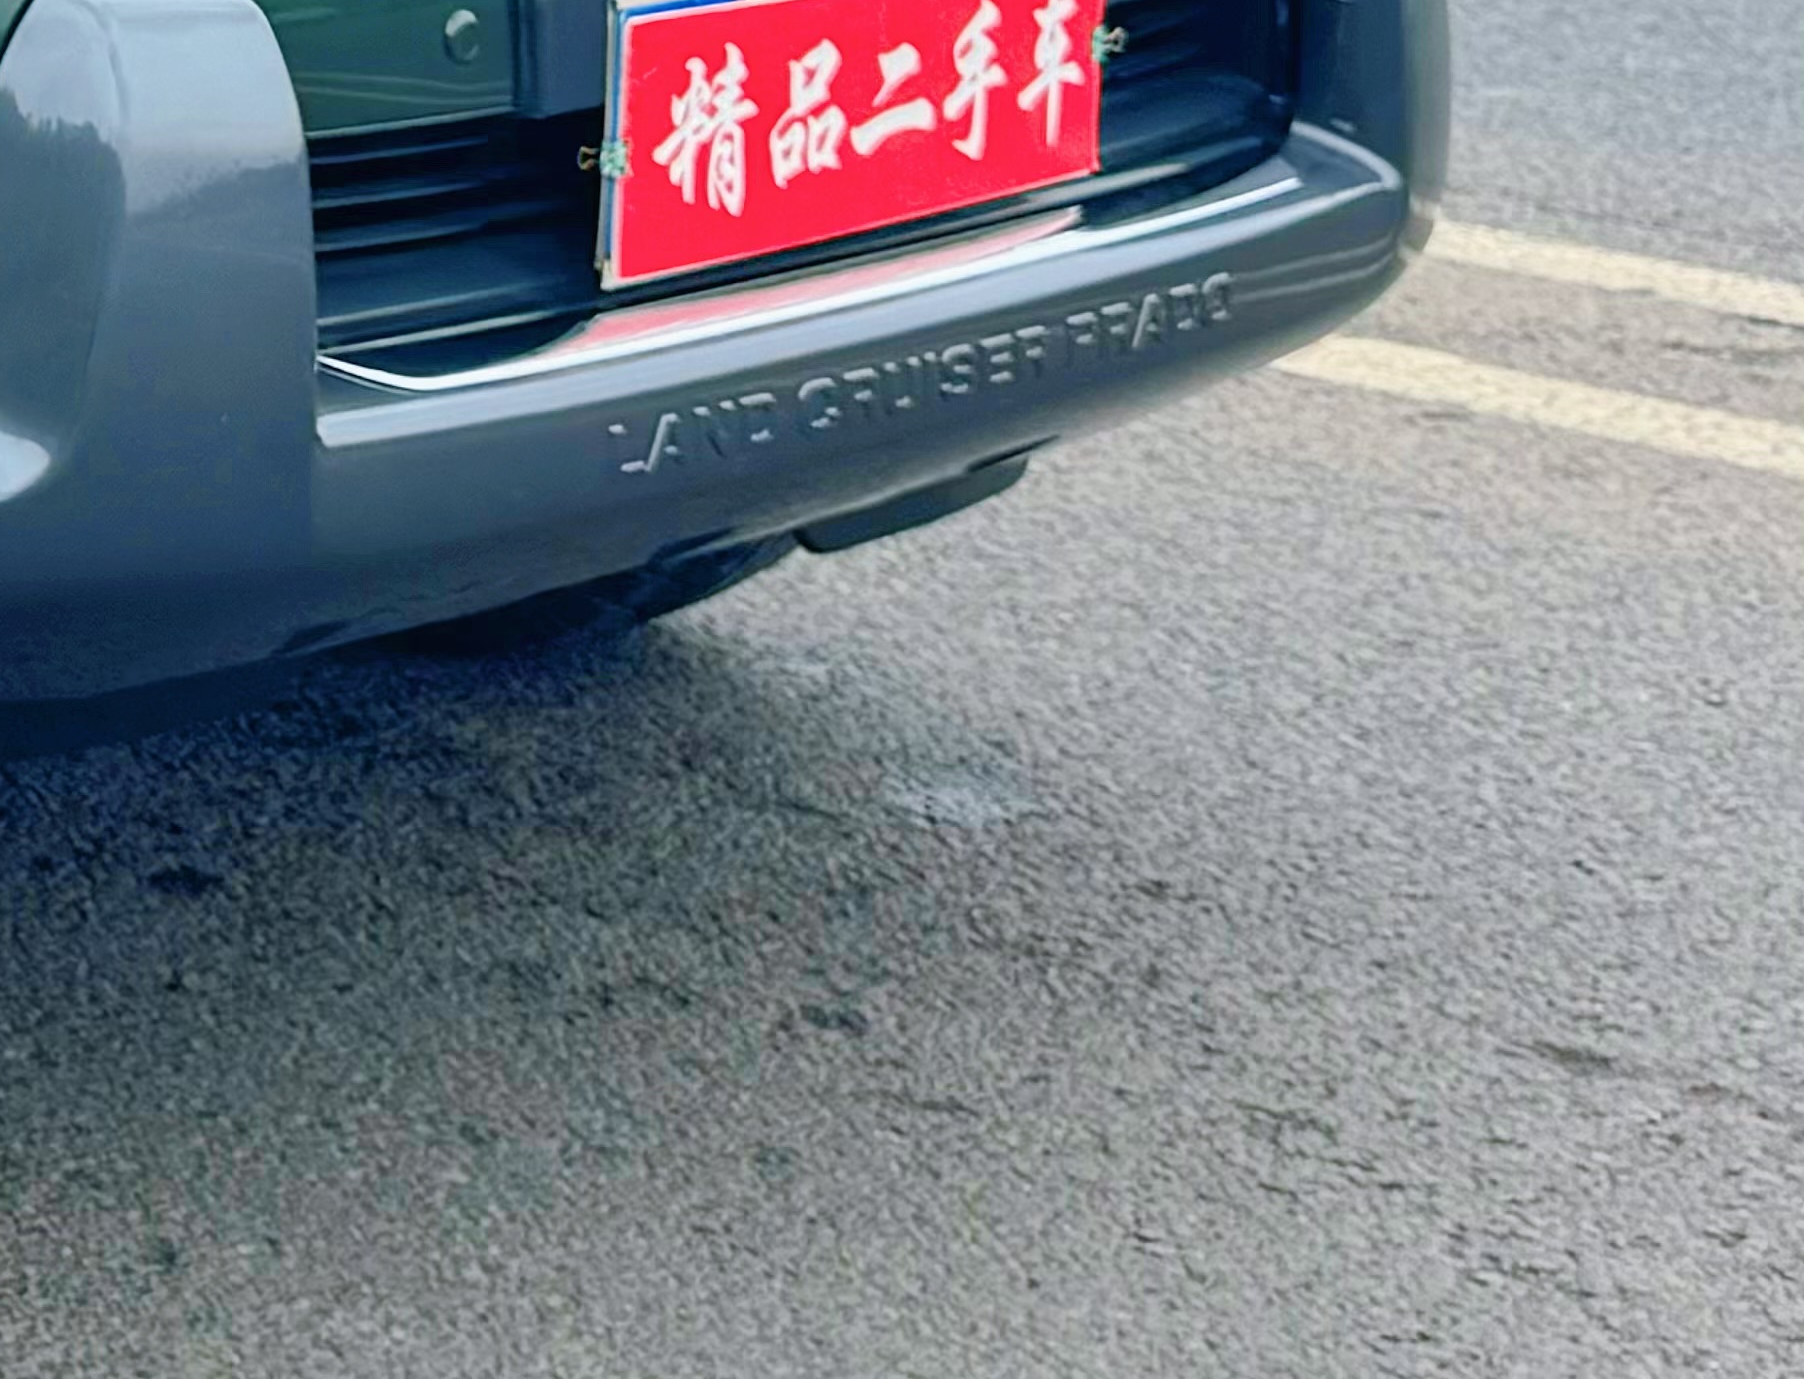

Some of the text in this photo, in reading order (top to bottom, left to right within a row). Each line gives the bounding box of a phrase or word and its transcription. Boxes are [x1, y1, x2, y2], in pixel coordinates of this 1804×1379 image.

[607, 271, 1234, 473] LAND CRUISER PRADO
